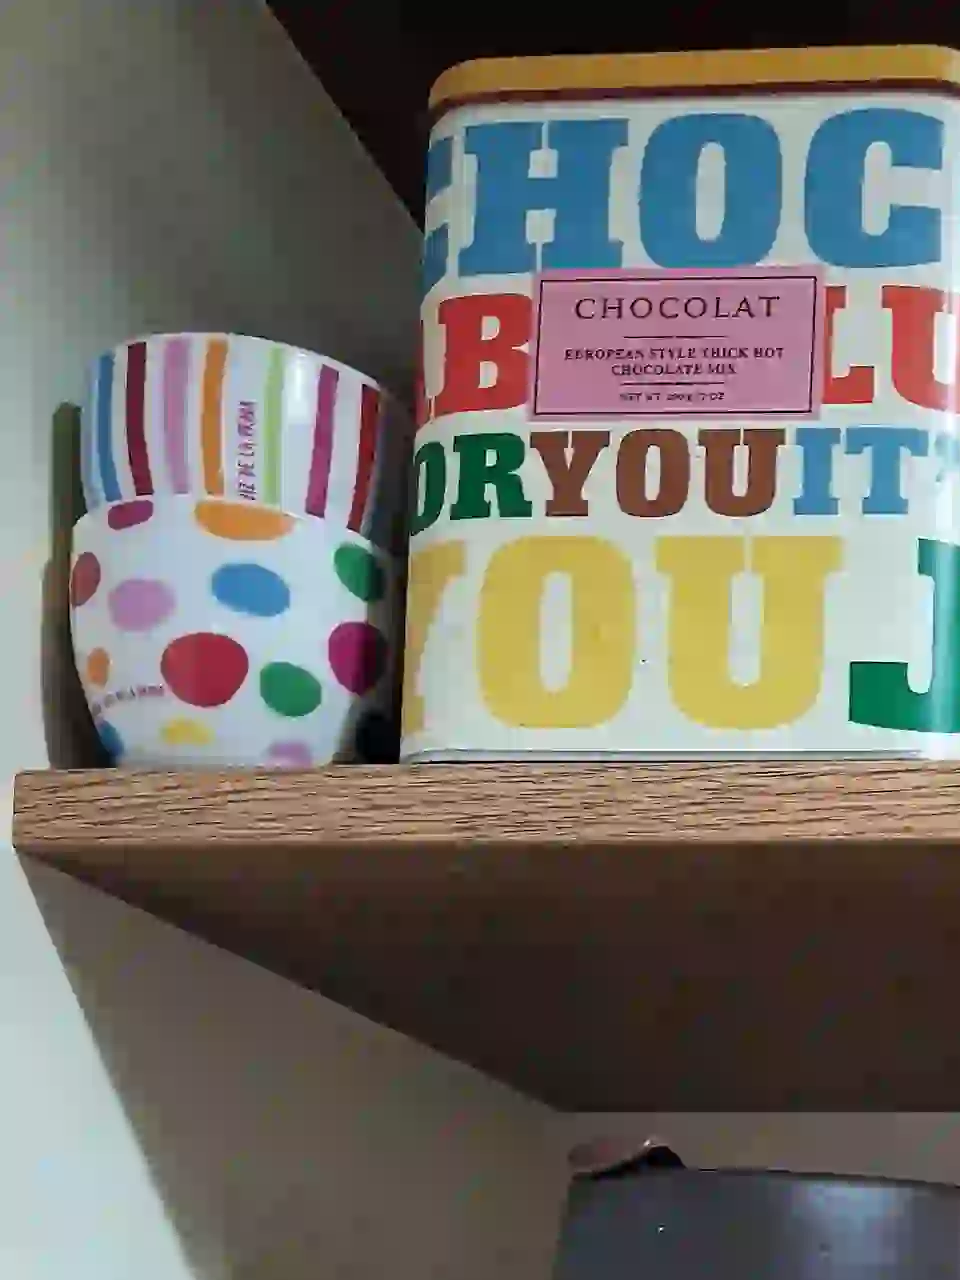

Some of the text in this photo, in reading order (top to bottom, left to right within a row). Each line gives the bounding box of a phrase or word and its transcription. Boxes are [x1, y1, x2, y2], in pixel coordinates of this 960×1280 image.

[574, 296, 781, 320] CHOCOLAT
[564, 346, 785, 361] EUROPEAN STYLE THICK HOT
[611, 362, 737, 376] CHOCOLATE MIX
[529, 428, 787, 518] YOU
